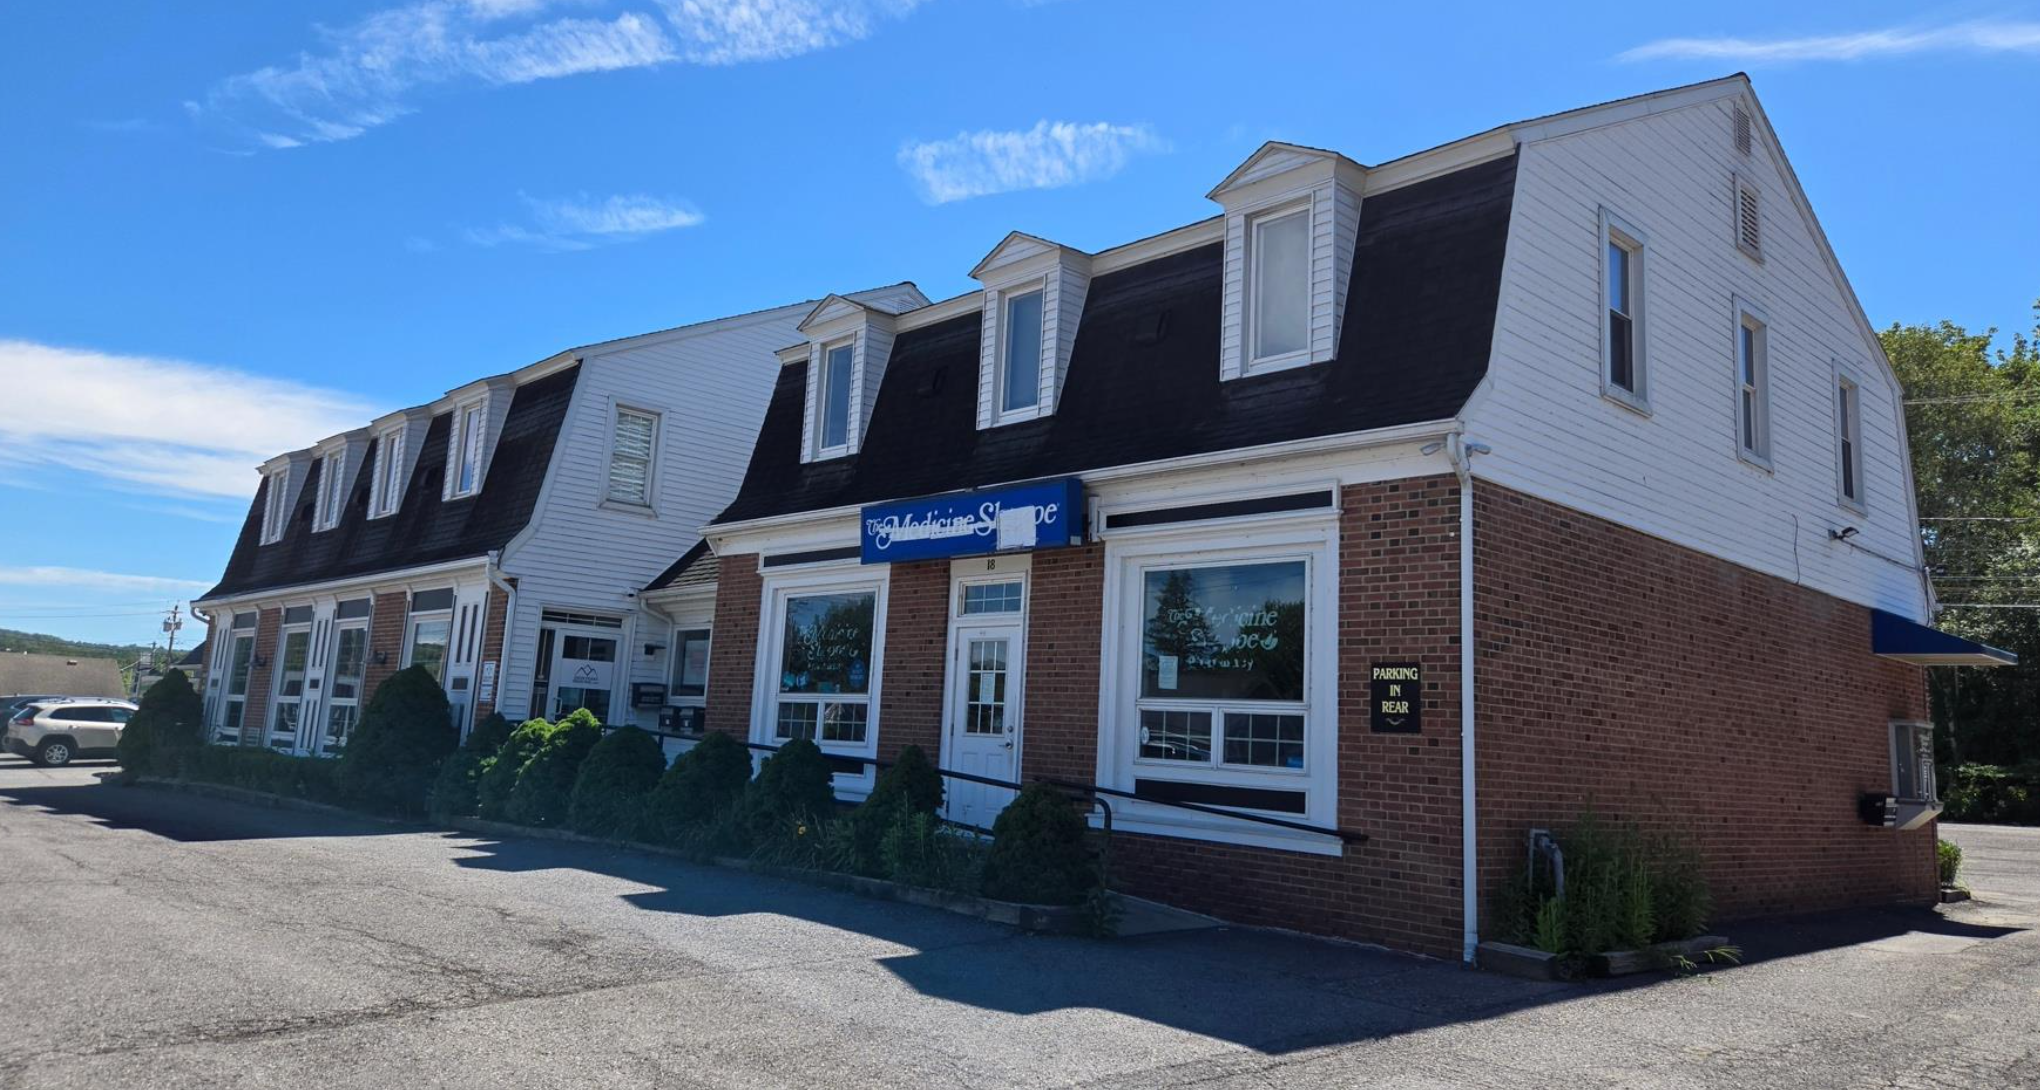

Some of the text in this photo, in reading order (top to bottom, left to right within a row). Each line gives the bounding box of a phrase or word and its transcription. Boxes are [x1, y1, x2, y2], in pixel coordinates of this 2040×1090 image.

[986, 558, 997, 571] 18
[1373, 667, 1419, 680] PARKING
[1389, 684, 1402, 697] IN
[1381, 700, 1410, 714] REAR
